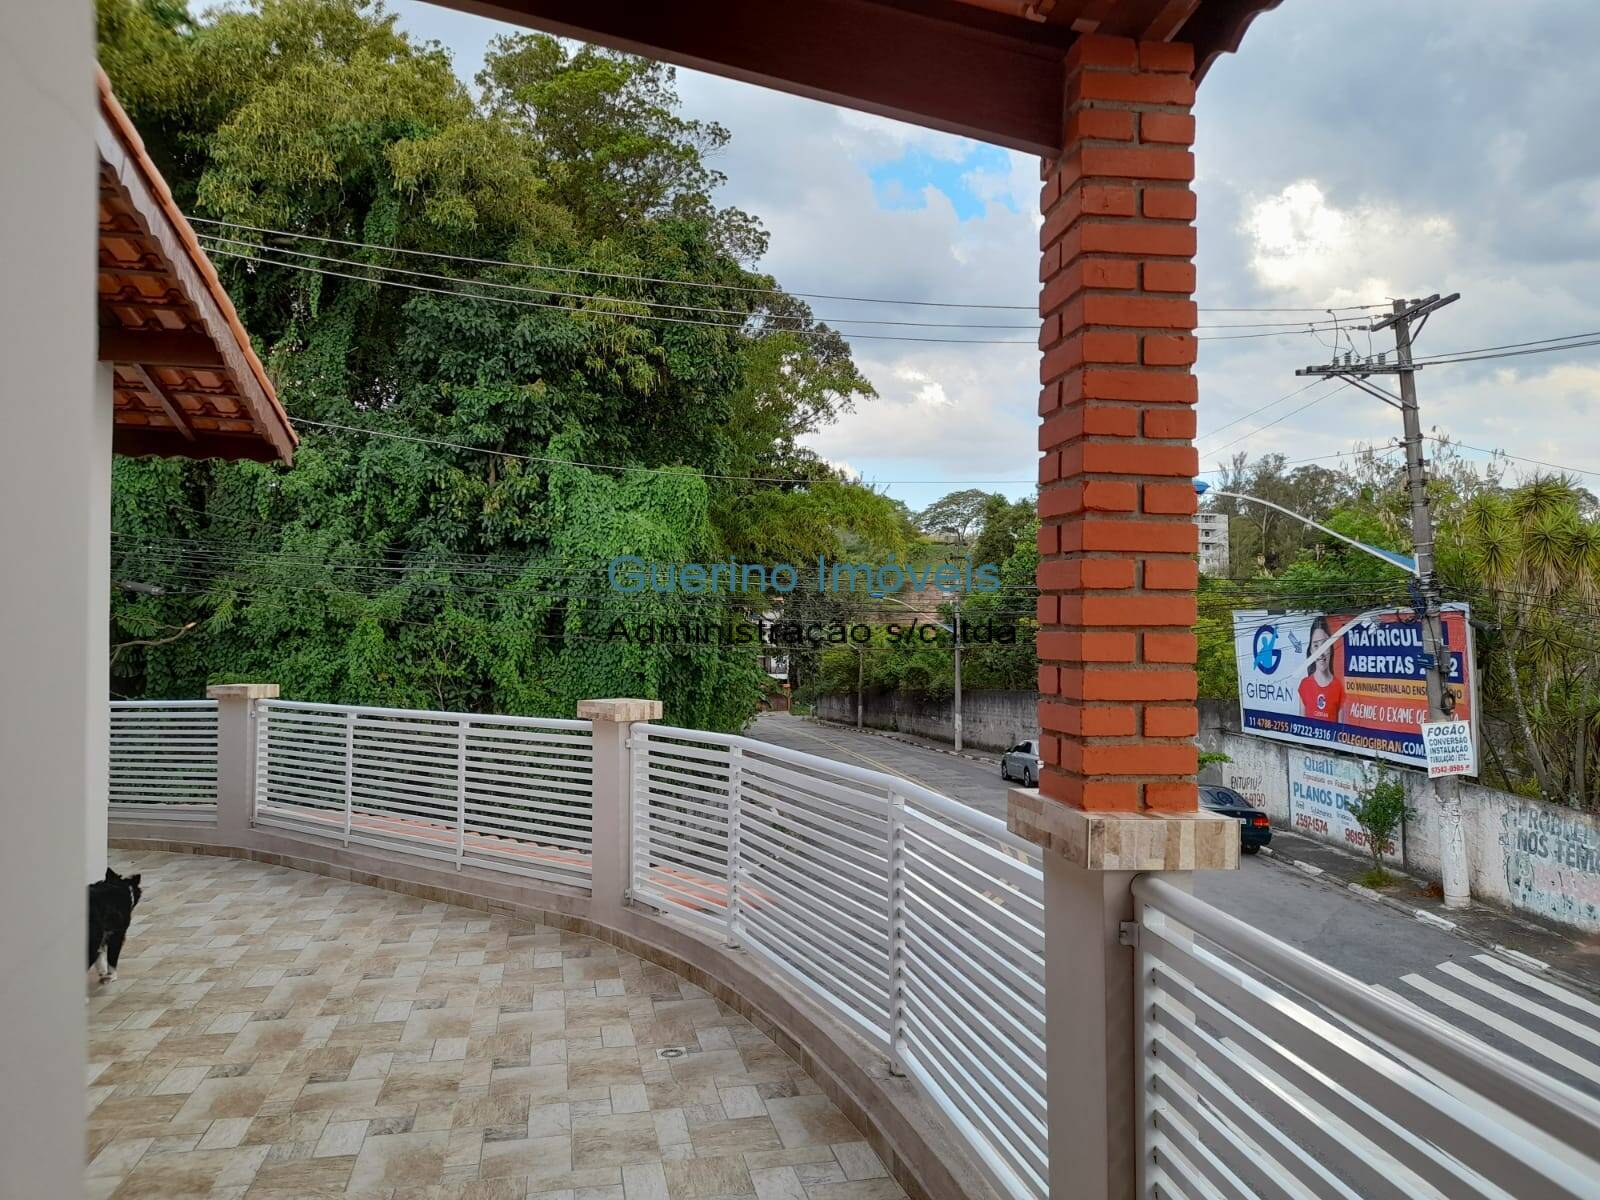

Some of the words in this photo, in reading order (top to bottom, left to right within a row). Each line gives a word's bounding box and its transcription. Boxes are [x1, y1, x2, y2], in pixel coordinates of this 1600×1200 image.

[1348, 625, 1443, 647] MATRÍCUL
[1349, 655, 1415, 675] ABERTAS
[1246, 682, 1294, 702] GIBRAN
[1346, 681, 1355, 690] DO
[1249, 716, 1256, 726] 11
[1350, 702, 1378, 721] AGENDE
[1379, 706, 1385, 722] O
[1386, 706, 1415, 724] EXAME
[1427, 724, 1466, 737] FOGÃO
[1429, 736, 1468, 747] CONVERSÃO
[1430, 744, 1468, 754] INSTALAÇÃO
[1293, 782, 1333, 807] PLANOS
